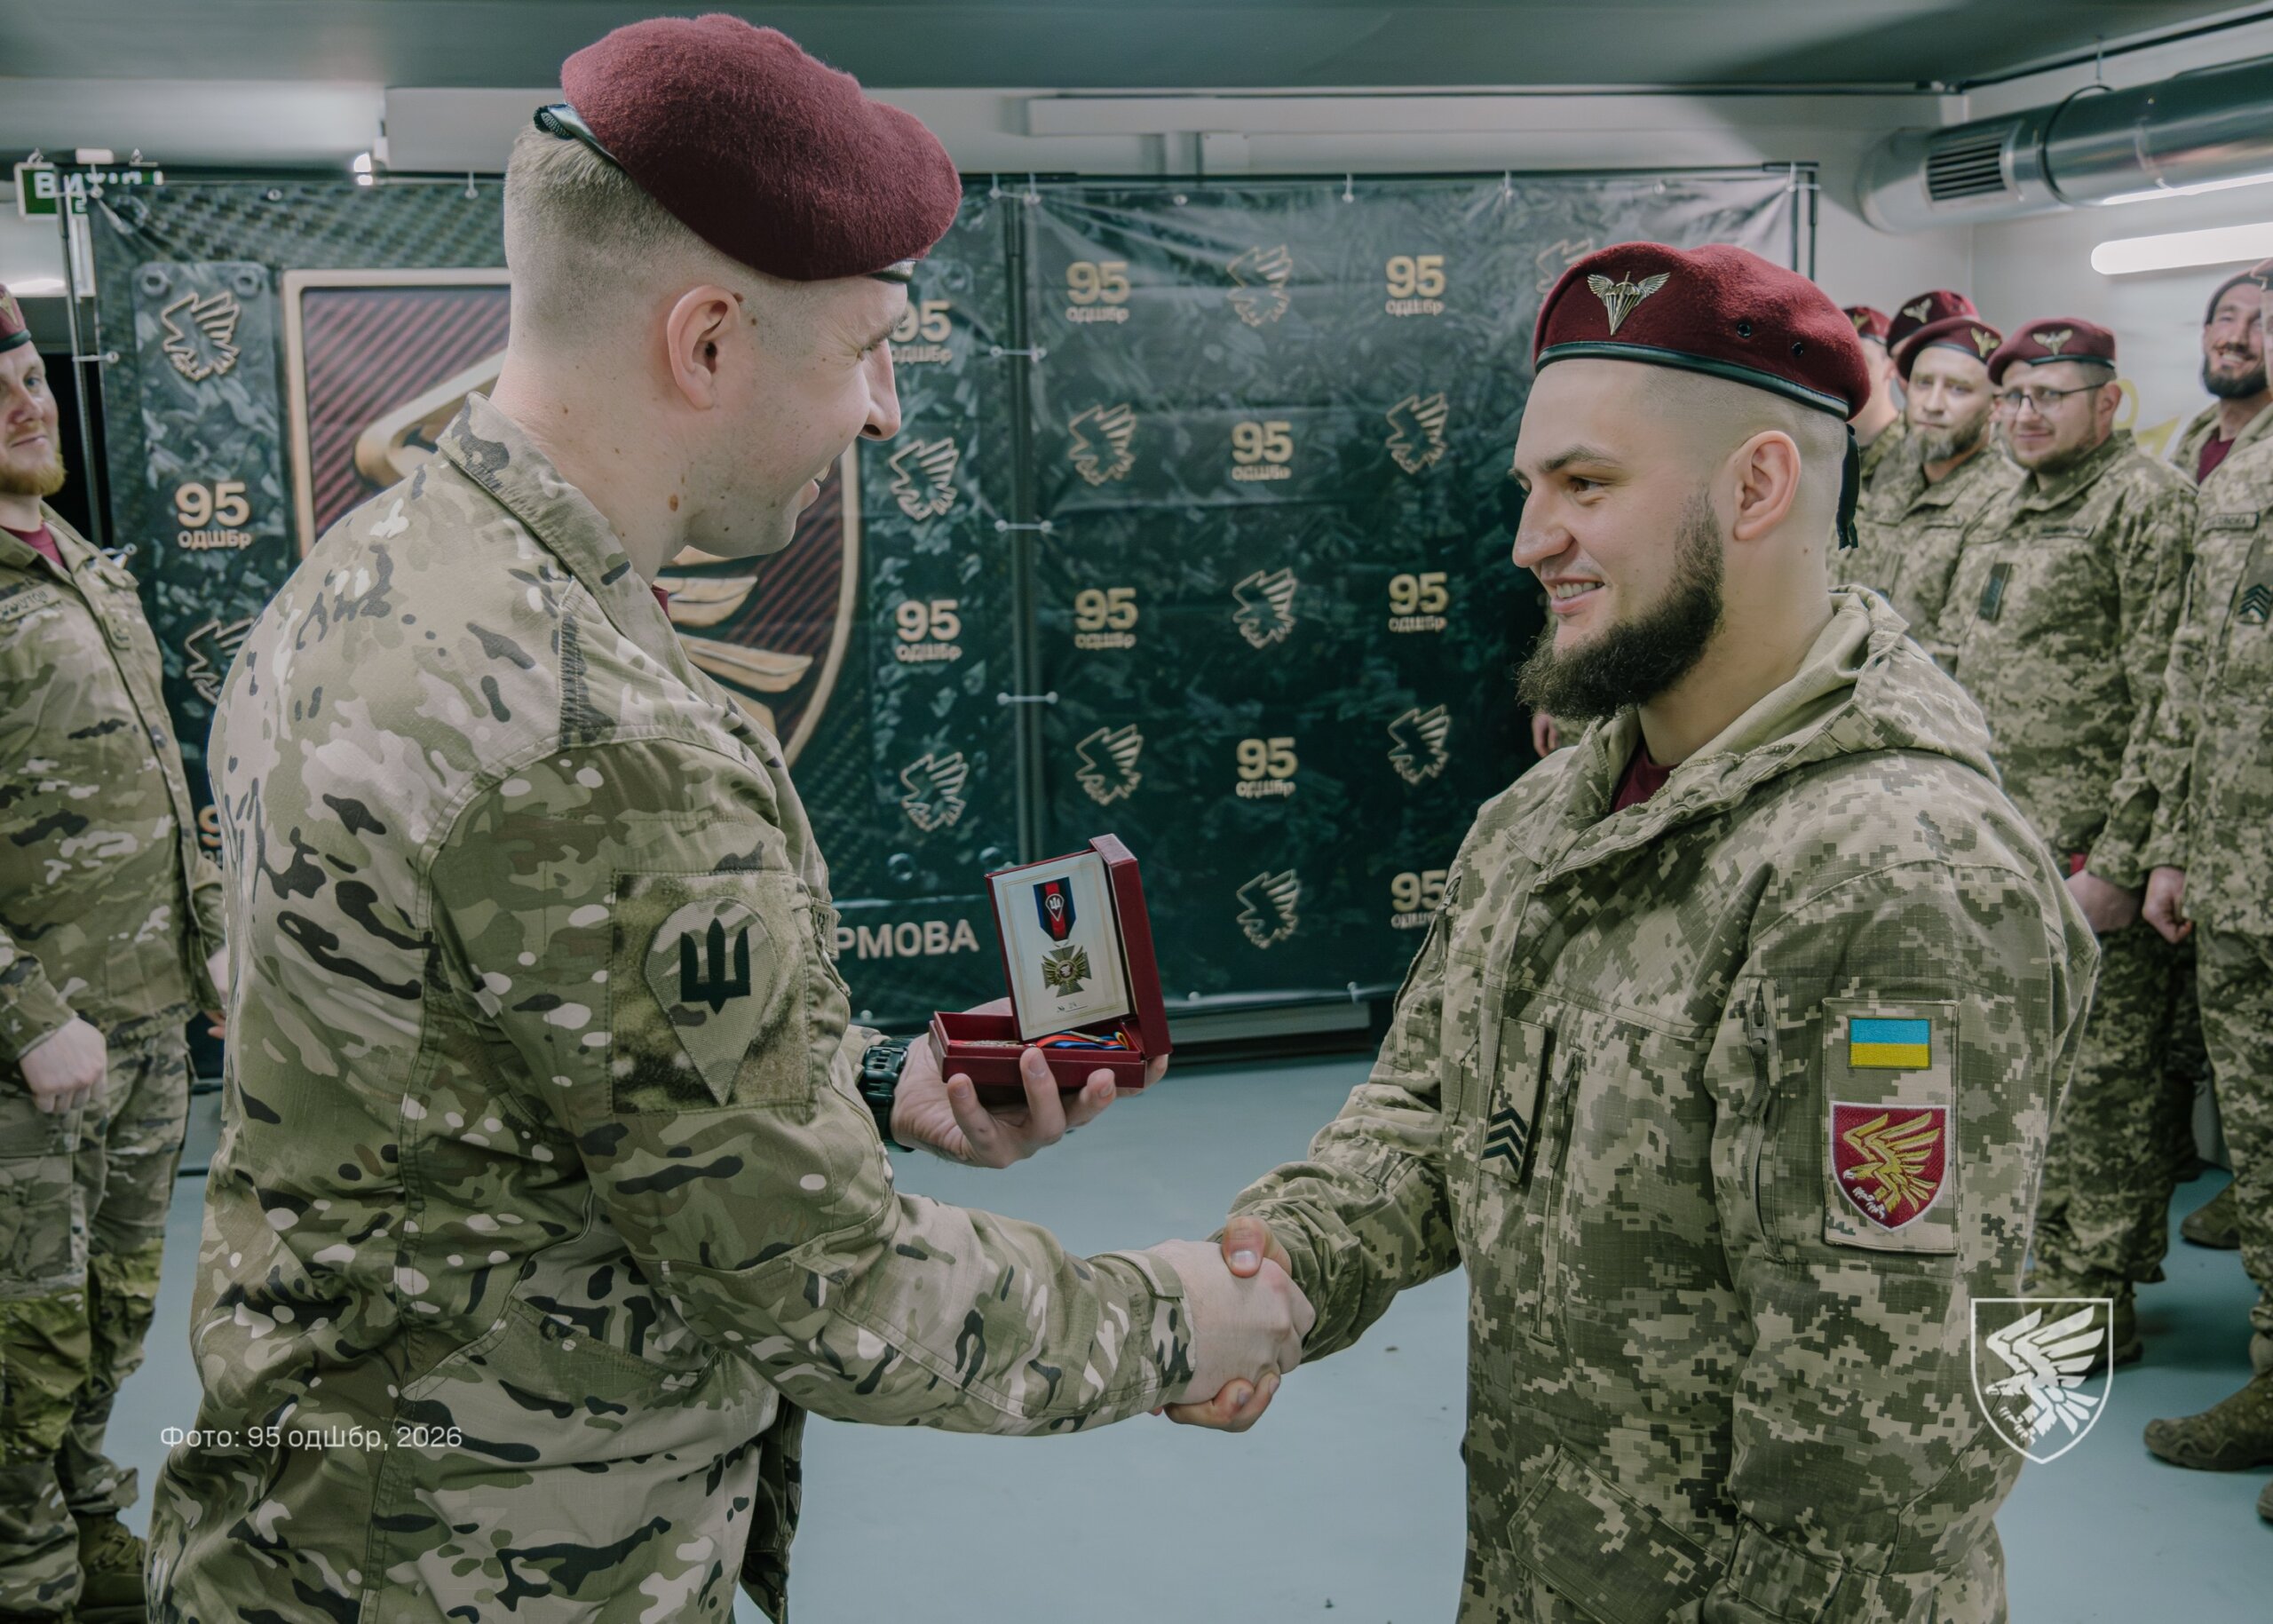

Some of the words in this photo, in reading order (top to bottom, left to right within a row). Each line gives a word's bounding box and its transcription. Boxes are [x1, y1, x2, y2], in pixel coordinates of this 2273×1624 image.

[1066, 261, 1129, 305] 95
[1386, 255, 1445, 298] 95
[1232, 421, 1293, 463] 95
[175, 482, 249, 527] 95
[1074, 587, 1138, 630] 95
[1389, 572, 1448, 614] 95
[896, 599, 961, 641] 95
[1236, 736, 1298, 780] 95
[1390, 869, 1448, 912] 95
[836, 918, 980, 961] РМОВА
